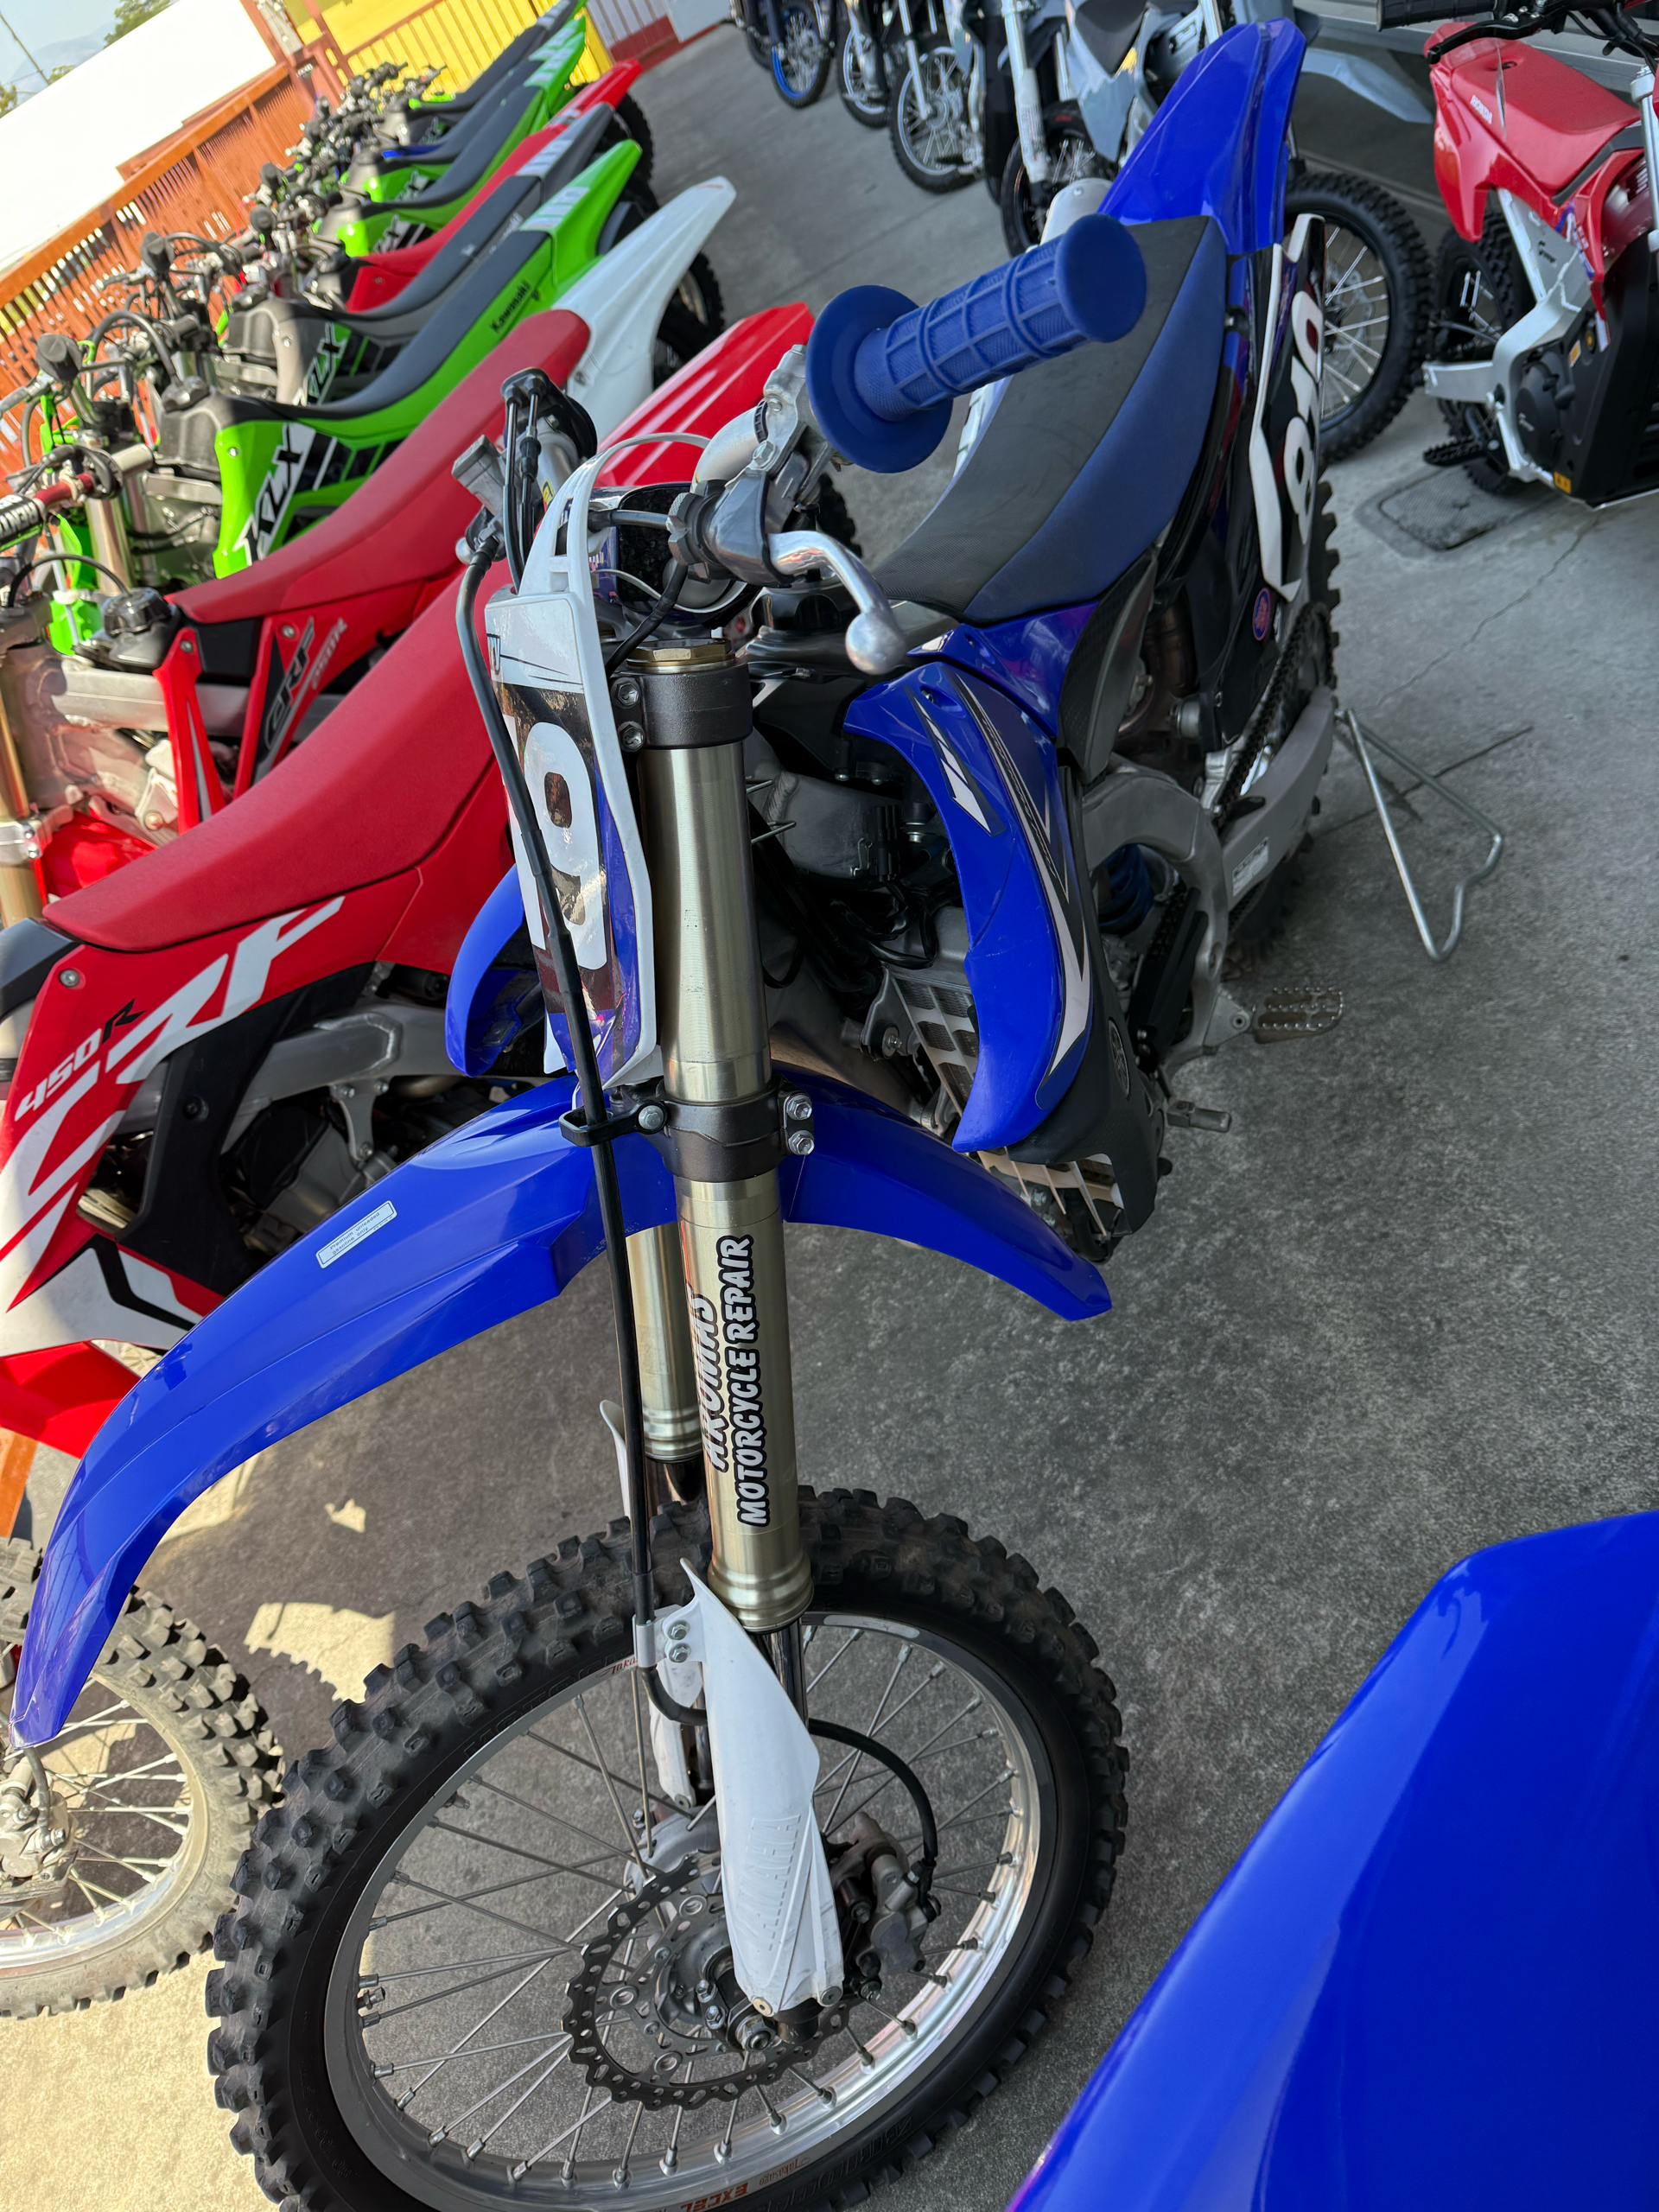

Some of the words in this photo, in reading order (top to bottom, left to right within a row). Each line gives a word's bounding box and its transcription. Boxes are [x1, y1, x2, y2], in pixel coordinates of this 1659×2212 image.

[489, 279, 531, 334] Kawasaki
[15, 999, 147, 1122] 450R
[329, 1231, 353, 1250] Premium
[355, 1211, 380, 1232] unleaded
[332, 1236, 355, 1255] gasoline
[357, 1226, 369, 1236] only
[718, 1236, 758, 1342] REPAIR
[727, 1348, 769, 1526] MOTORCYCLE
[758, 2157, 811, 2185] Takasago
[679, 2181, 748, 2212] EXCEL
